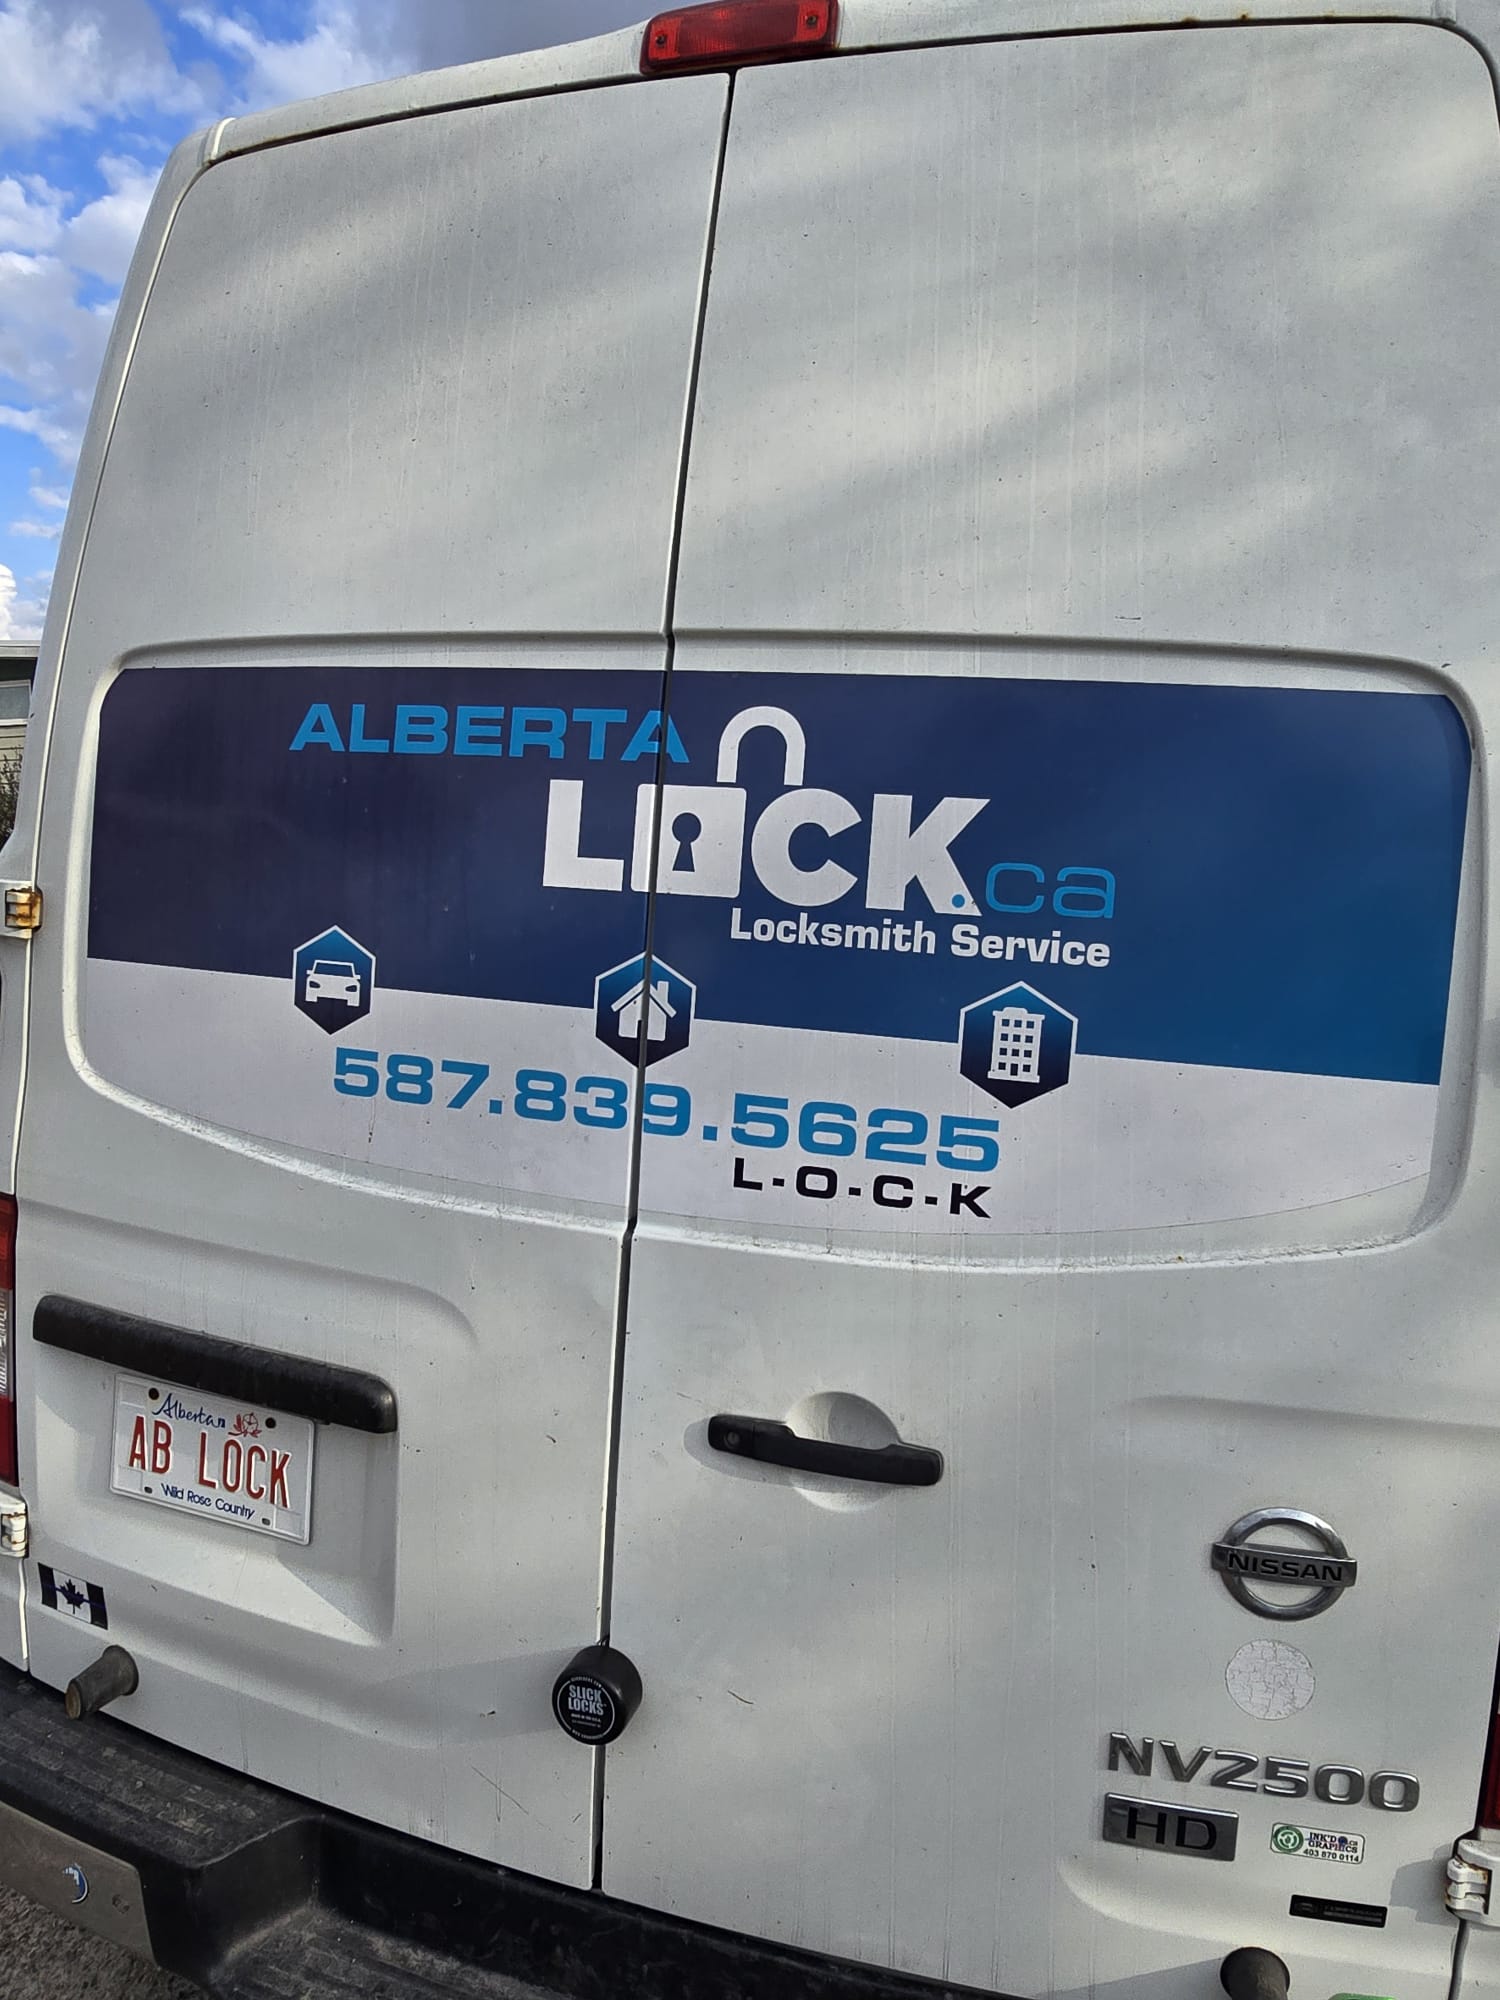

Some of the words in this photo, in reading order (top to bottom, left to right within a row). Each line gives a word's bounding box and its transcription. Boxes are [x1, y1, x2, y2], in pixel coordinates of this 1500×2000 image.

[289, 703, 690, 763] ALBERTA
[731, 907, 937, 955] Locksmith
[950, 923, 1111, 968] Service
[333, 1046, 1001, 1172] 587.839.5625
[128, 1415, 173, 1475] AB
[198, 1432, 291, 1509] LOCK
[161, 1482, 184, 1500] Wild
[186, 1490, 212, 1507] Rose
[215, 1498, 256, 1521] Country
[1228, 1553, 1343, 1582] NISSAN
[568, 1684, 603, 1702] SLICK
[568, 1697, 604, 1715] LOCKS
[1107, 1732, 1420, 1813] NV2500
[1125, 1806, 1217, 1851] HD
[1303, 1849, 1319, 1857] 403
[1339, 1853, 1359, 1862] 0114
